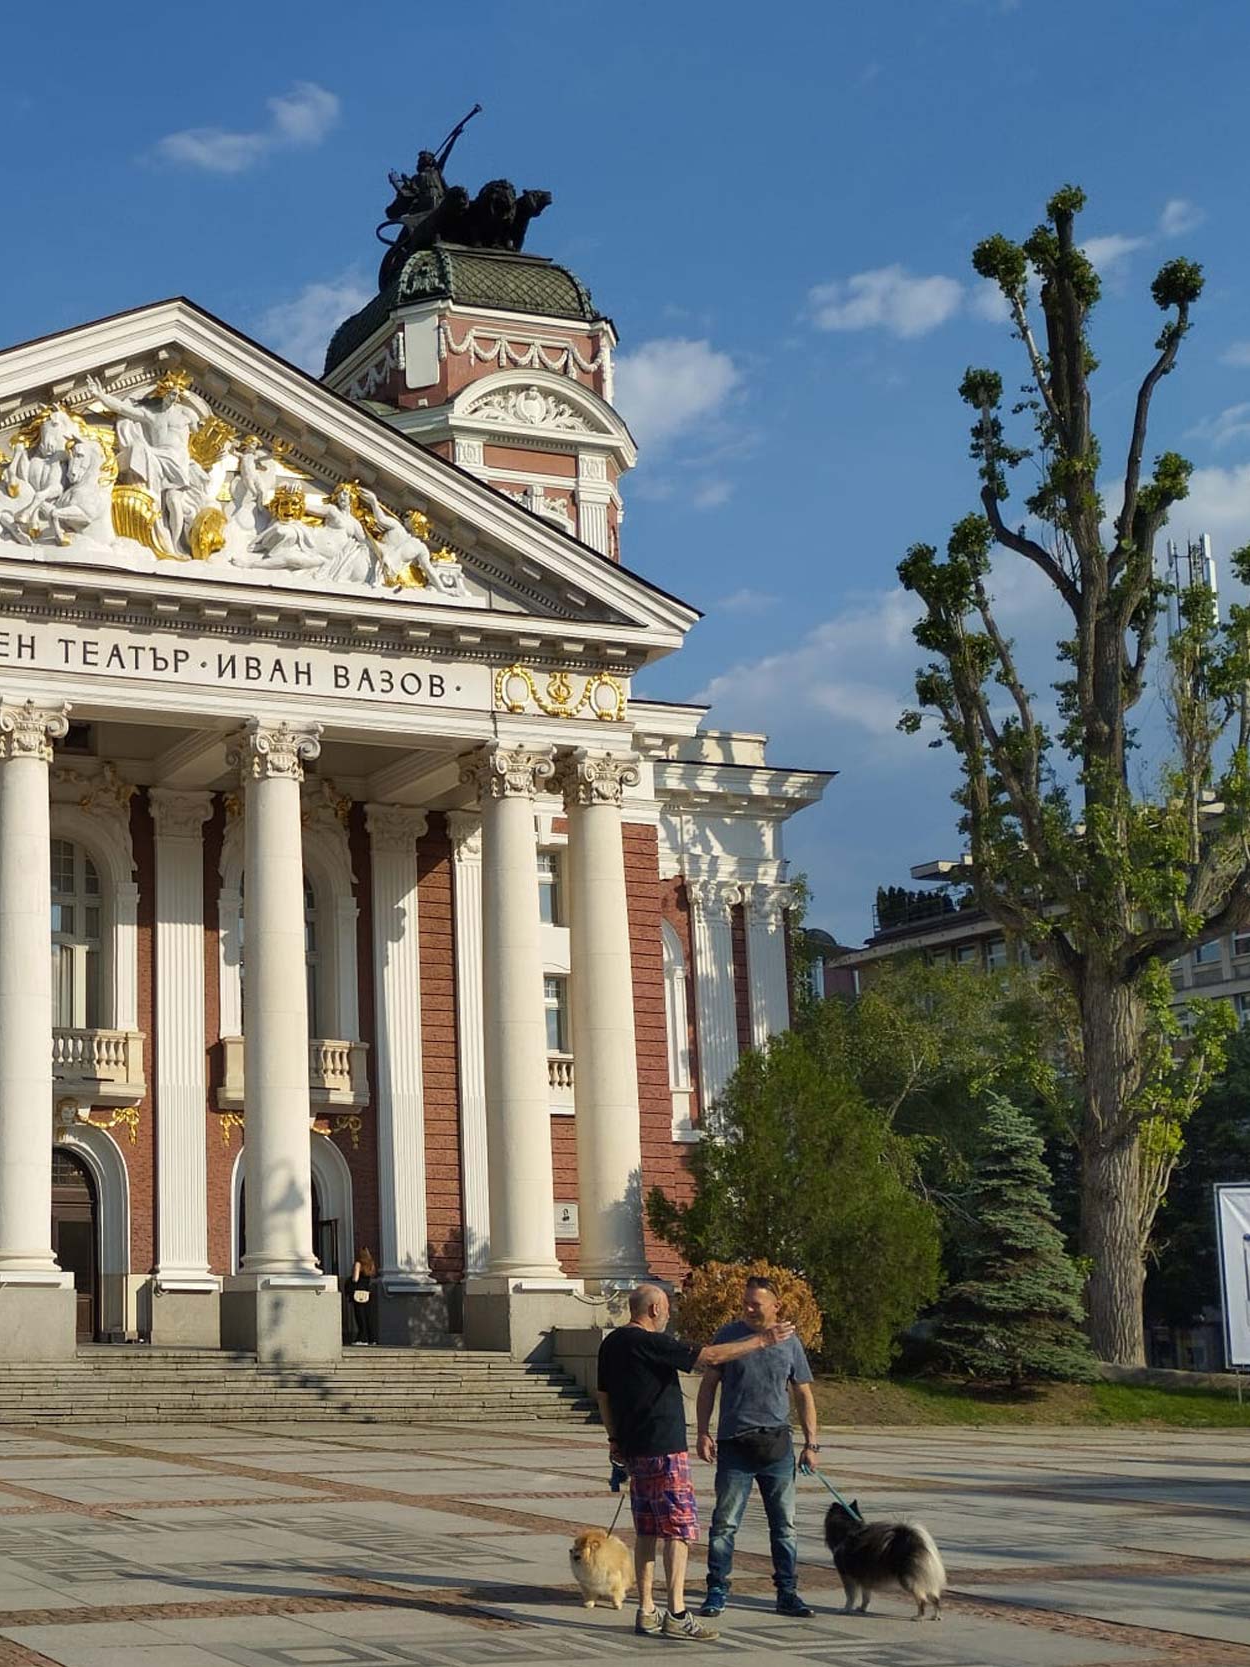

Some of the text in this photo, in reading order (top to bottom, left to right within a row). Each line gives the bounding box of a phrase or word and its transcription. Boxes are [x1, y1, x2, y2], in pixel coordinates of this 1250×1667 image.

[57, 638, 190, 673] ТЕАТЪР
[217, 653, 312, 686] ИВАН
[333, 664, 445, 698] ВАЗОВ
